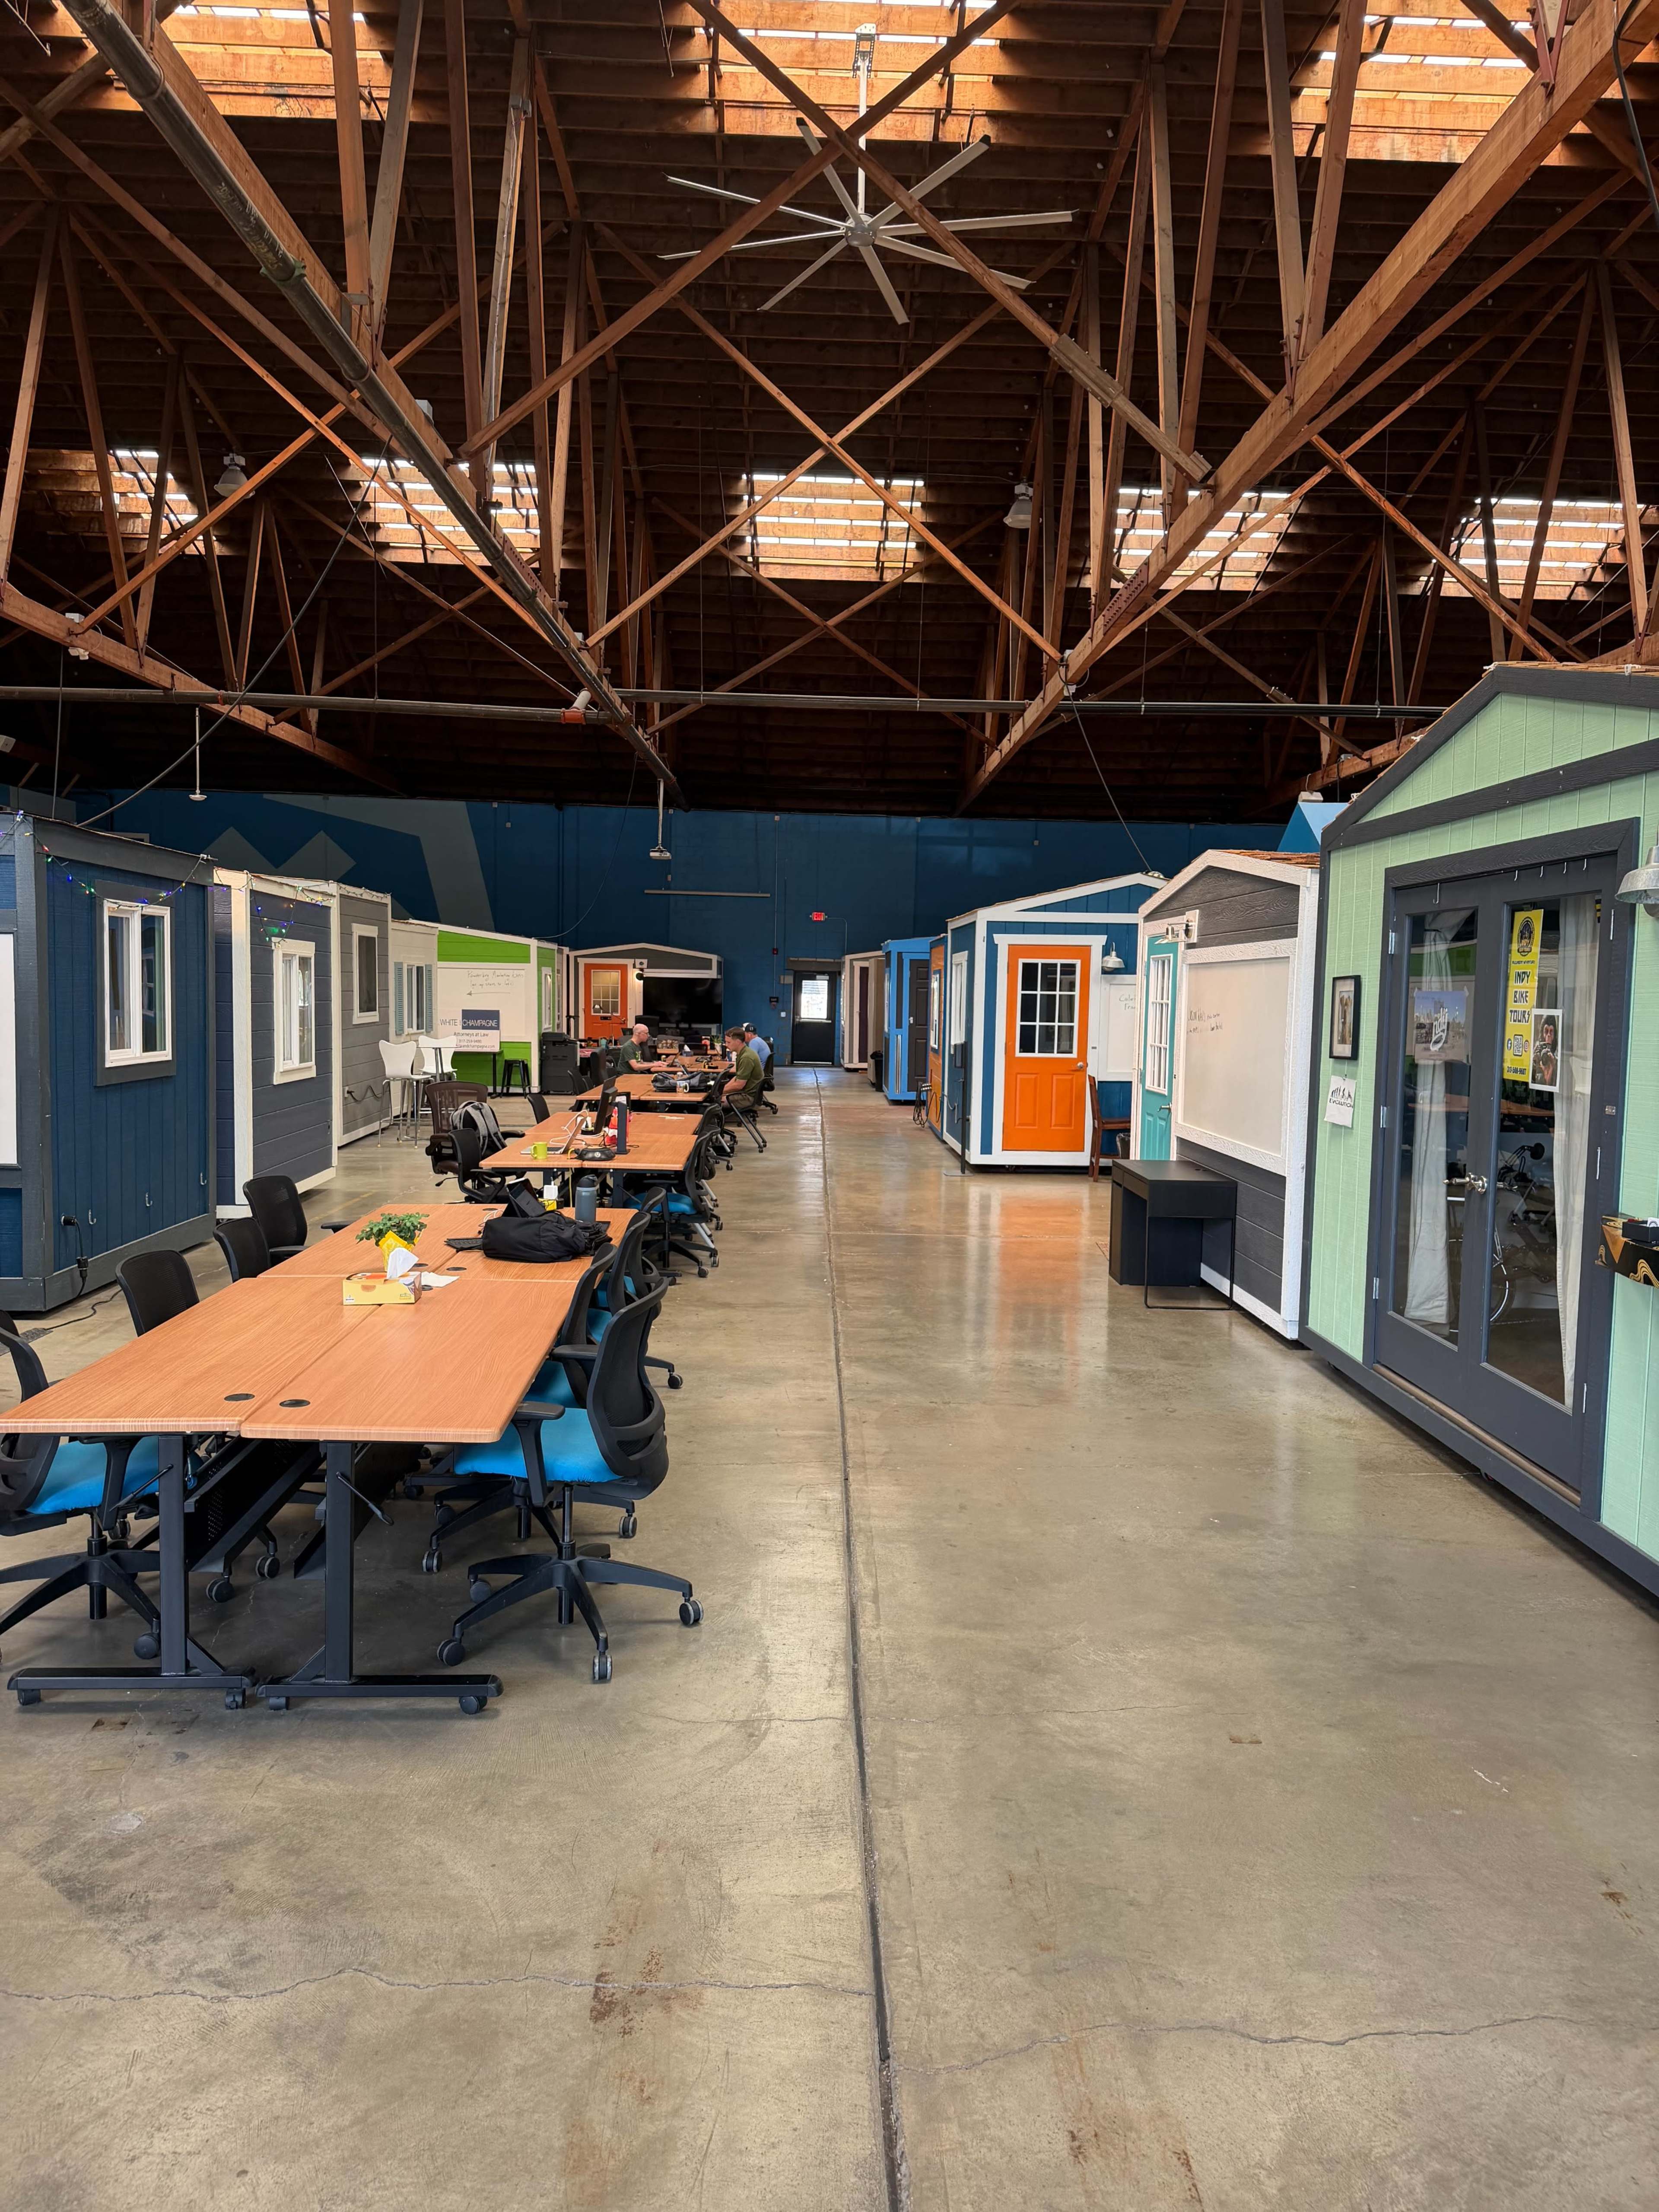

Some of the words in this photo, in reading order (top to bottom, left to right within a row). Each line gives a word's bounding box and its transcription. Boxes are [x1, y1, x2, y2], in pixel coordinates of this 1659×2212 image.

[1514, 971, 1531, 984] INDY
[1513, 990, 1529, 1003] BIKE
[1510, 1009, 1531, 1023] TOURS
[462, 1019, 498, 1027] CHAMPAGNE
